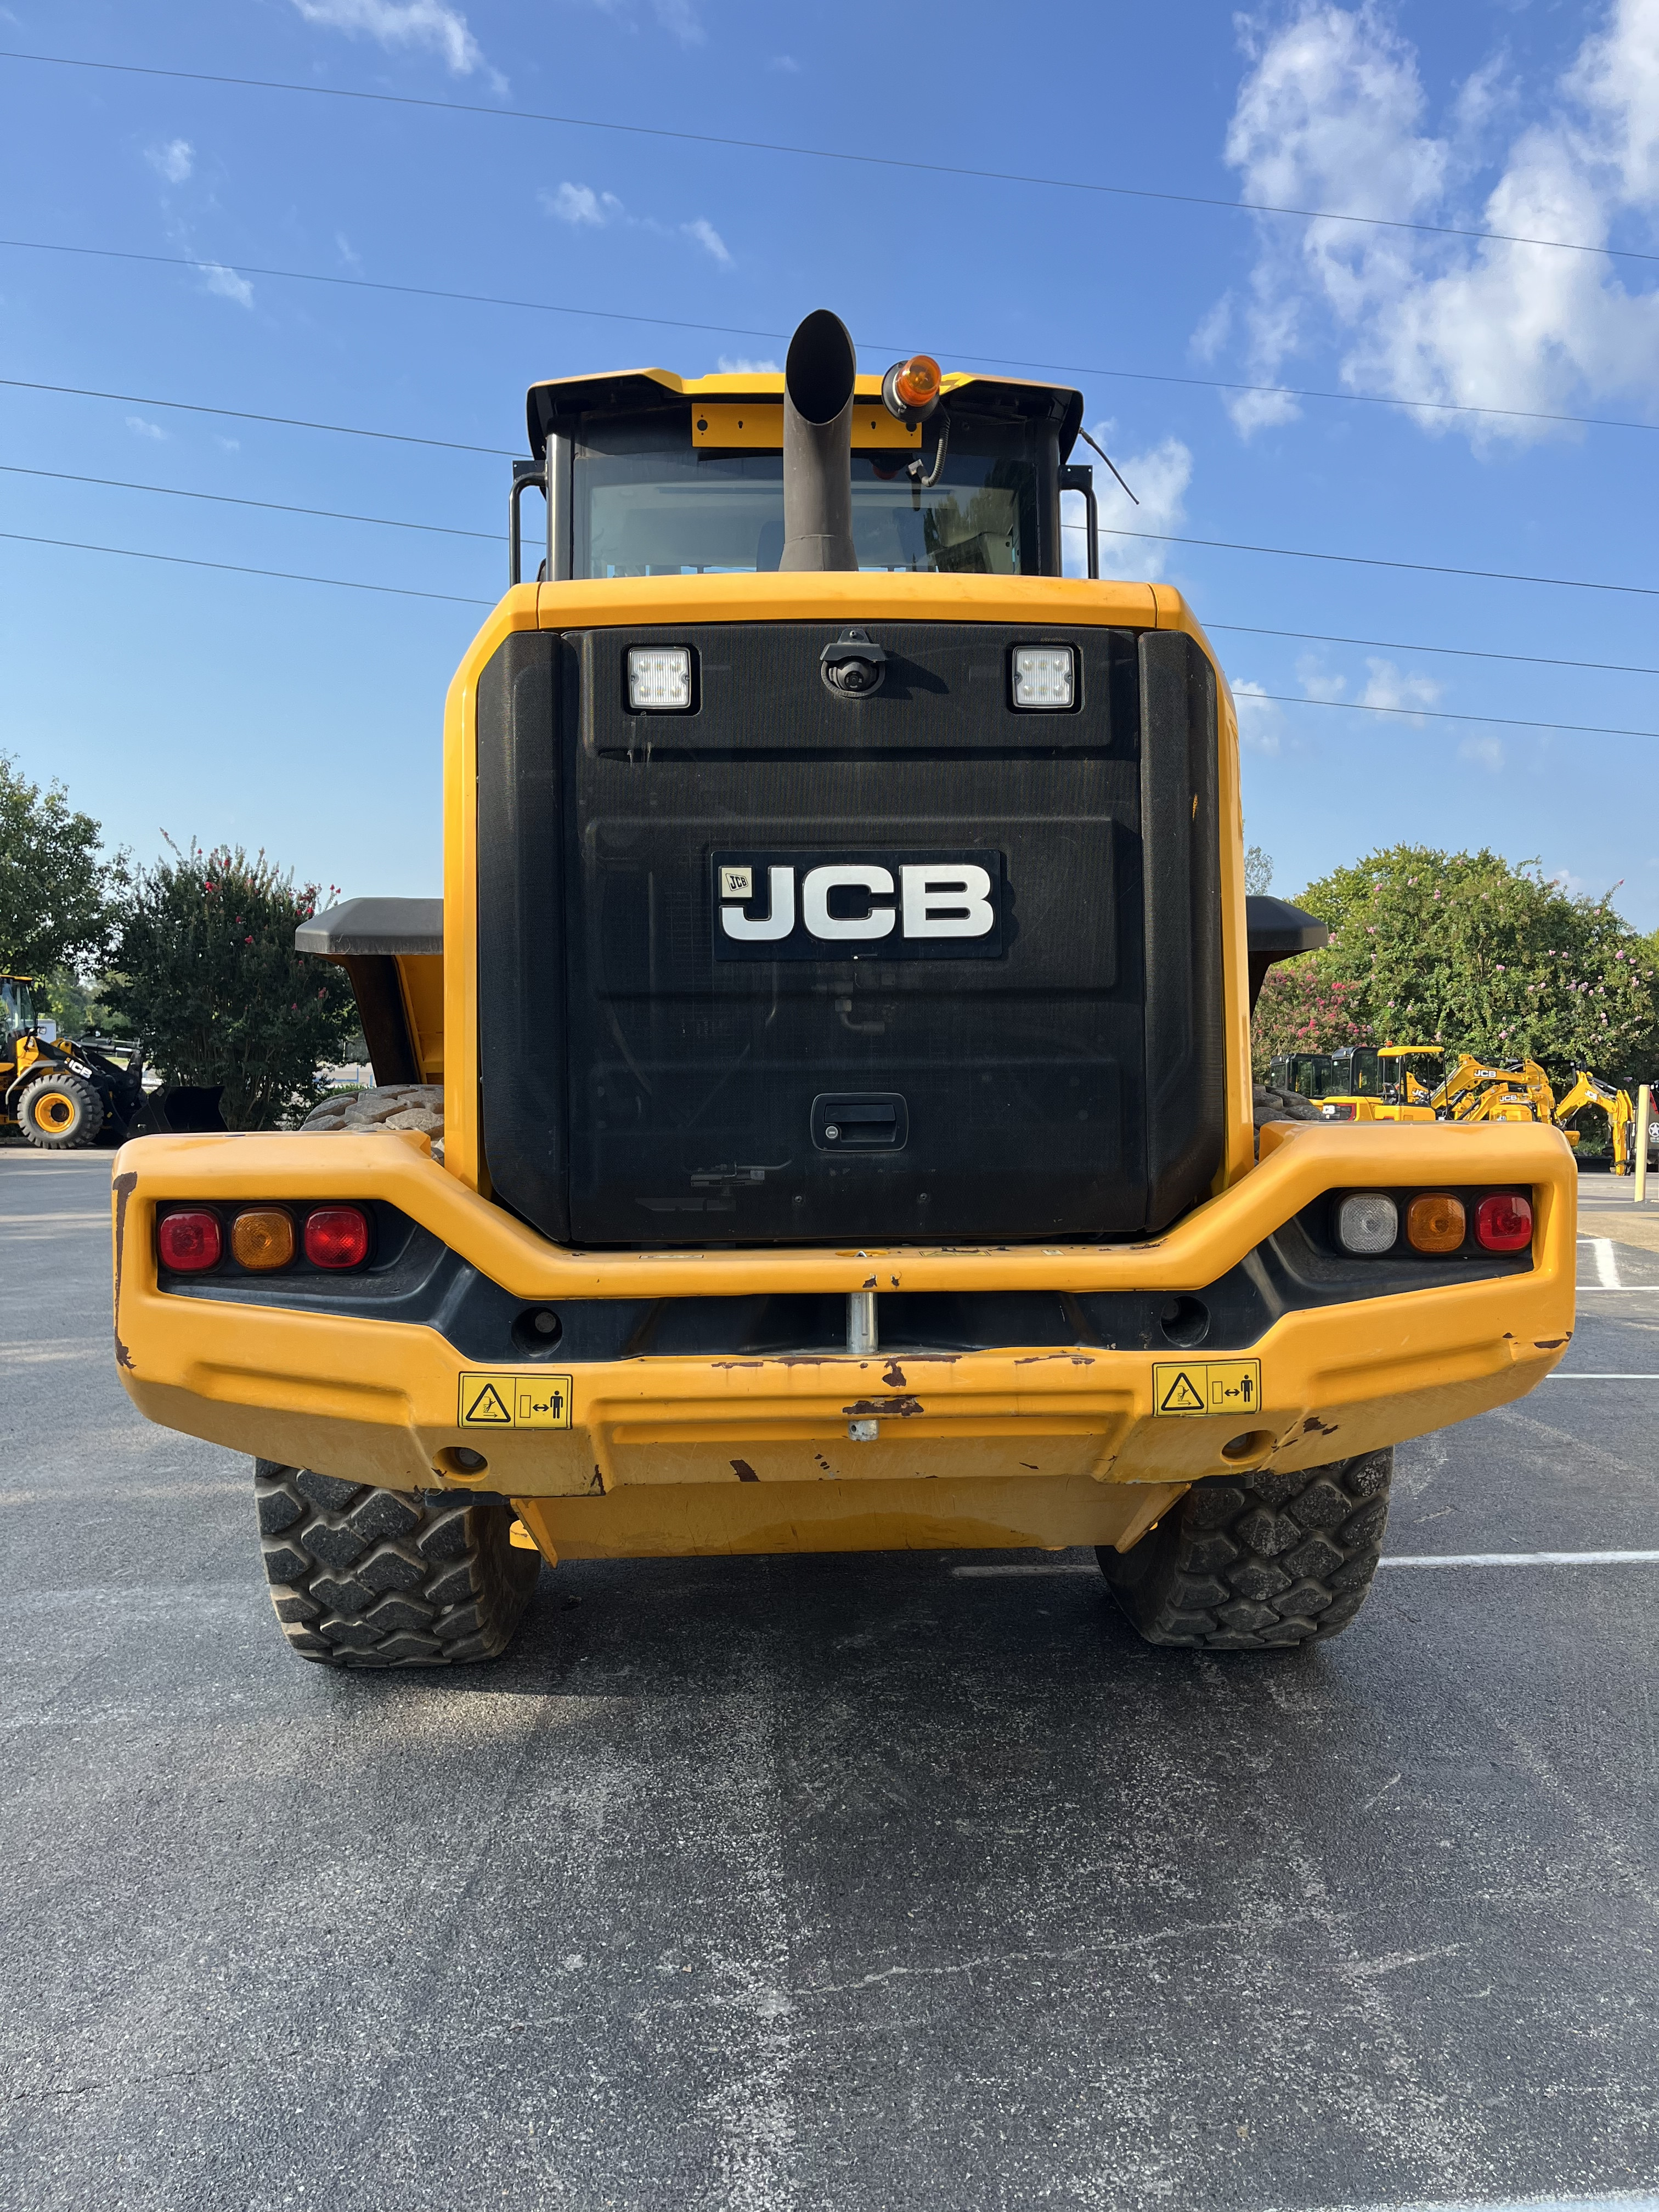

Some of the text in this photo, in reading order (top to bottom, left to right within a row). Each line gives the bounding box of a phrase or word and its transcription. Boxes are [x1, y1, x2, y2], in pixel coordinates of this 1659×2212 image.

[730, 876, 747, 889] JCB
[720, 865, 994, 940] JCB
[64, 1057, 92, 1079] JCB
[1474, 1069, 1497, 1077] JCB
[1412, 1088, 1429, 1099] JC
[1322, 1105, 1335, 1114] CB
